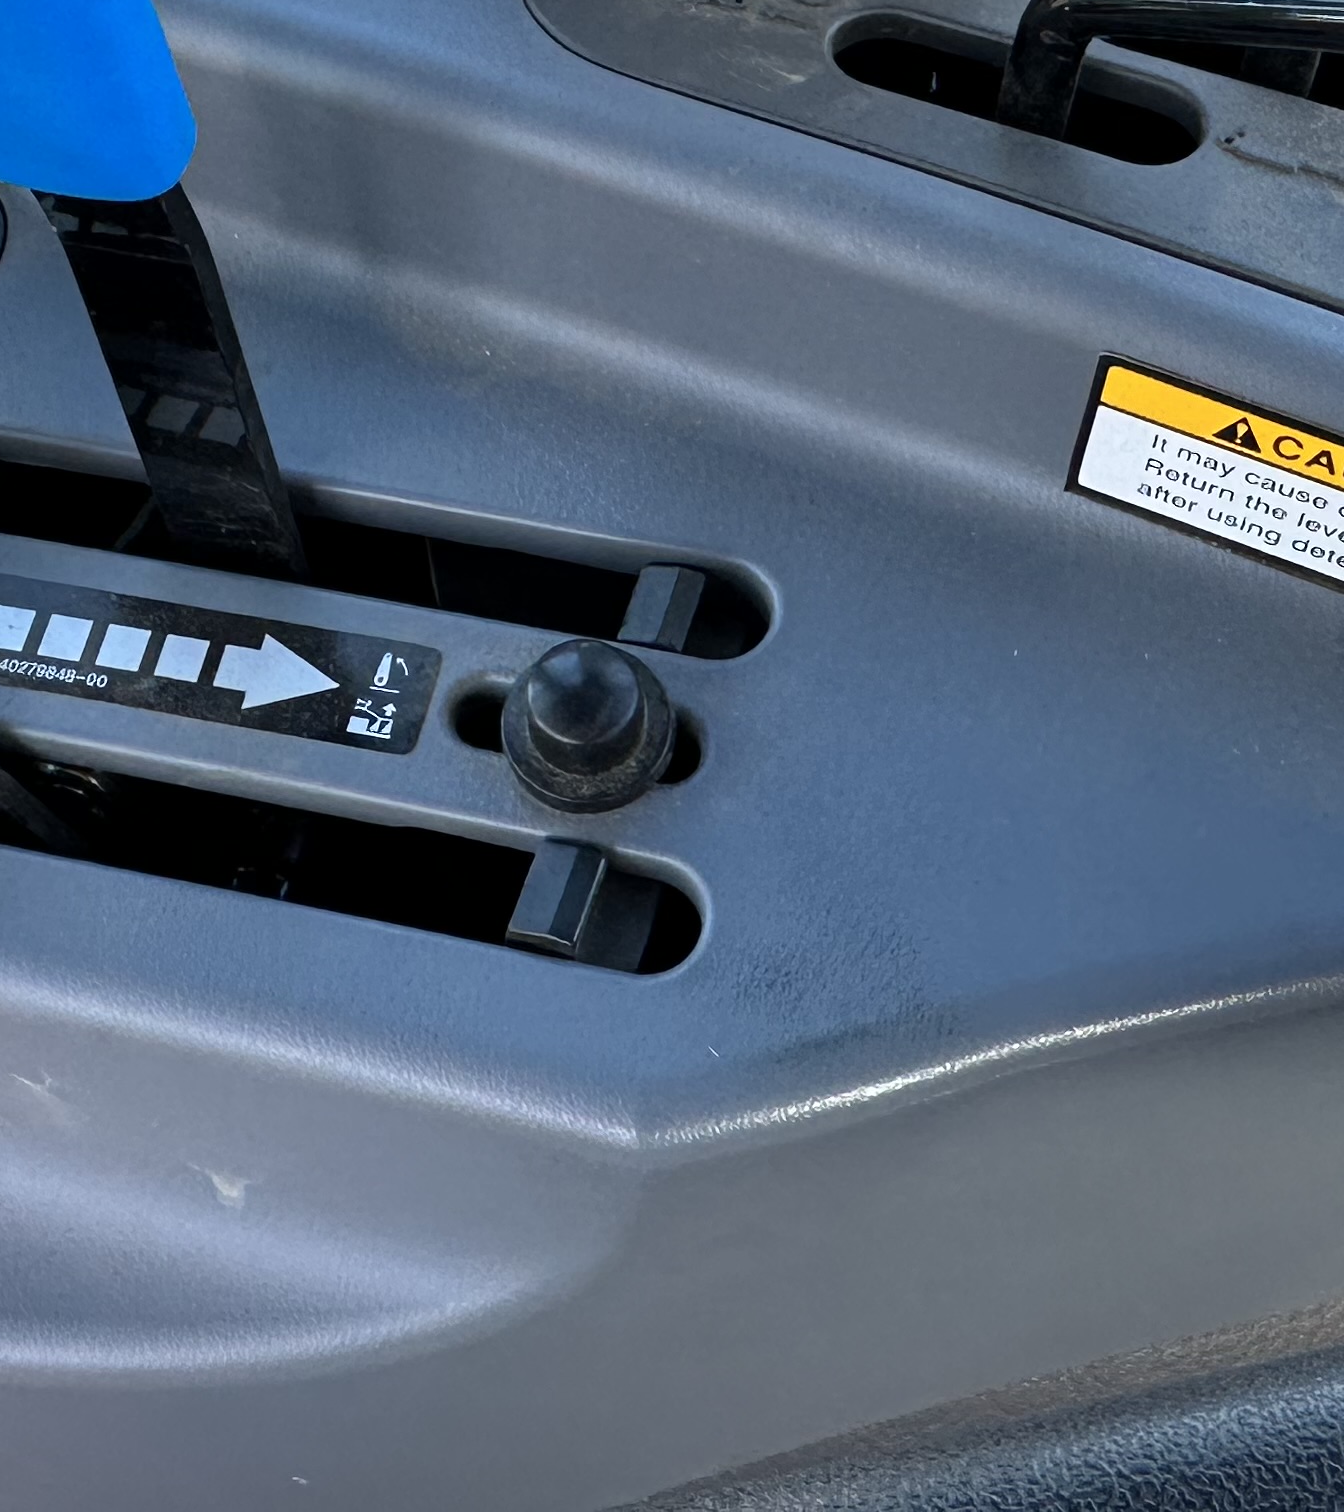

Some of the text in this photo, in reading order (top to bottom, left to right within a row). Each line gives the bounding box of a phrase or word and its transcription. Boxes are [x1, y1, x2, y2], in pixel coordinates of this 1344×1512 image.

[1144, 457, 1235, 503] Return
[1244, 494, 1288, 521] the
[1151, 434, 1168, 454] It
[1176, 447, 1237, 479] may
[1244, 472, 1329, 510] cause
[1136, 482, 1199, 513] after
[1206, 507, 1282, 547] using
